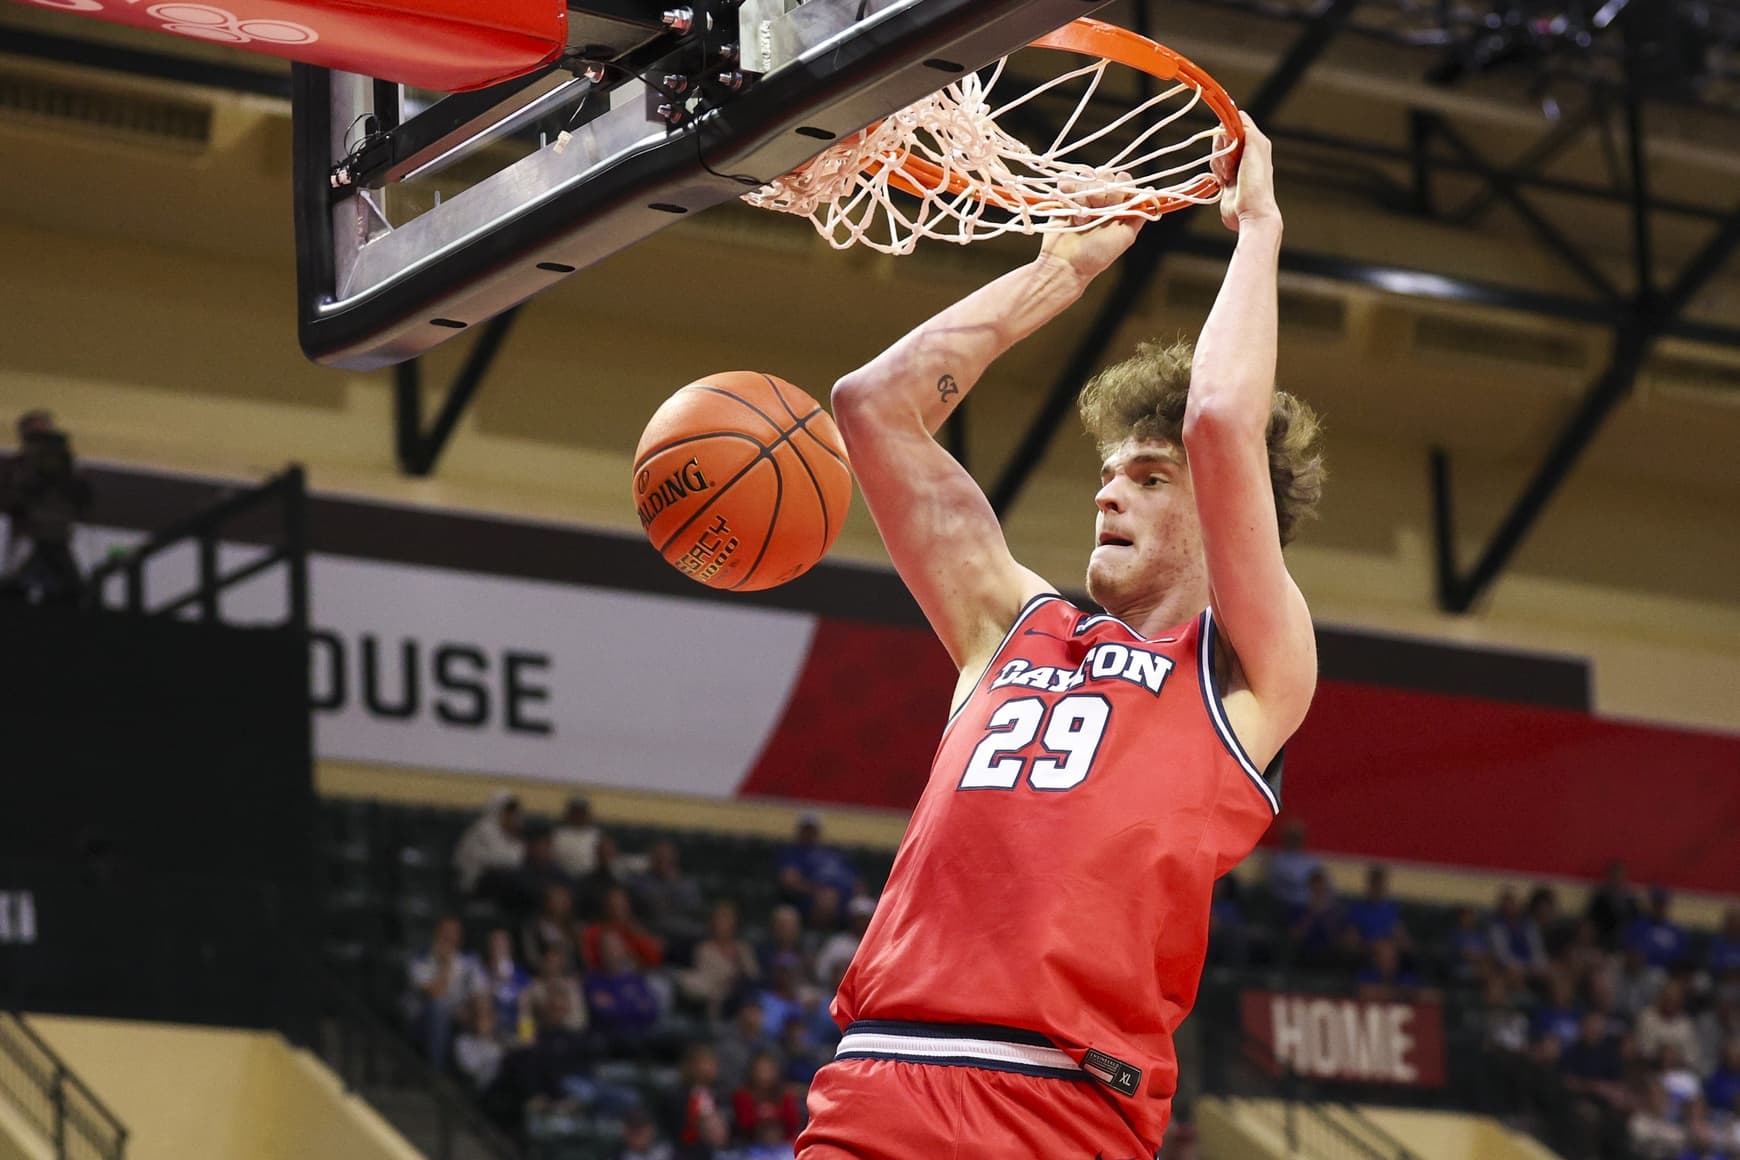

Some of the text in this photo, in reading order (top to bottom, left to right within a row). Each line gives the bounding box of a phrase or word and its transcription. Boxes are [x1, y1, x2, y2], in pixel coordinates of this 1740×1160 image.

[957, 693, 1112, 791] 29
[1119, 1071, 1132, 1087] XL
[1270, 995, 1419, 1083] HOME
